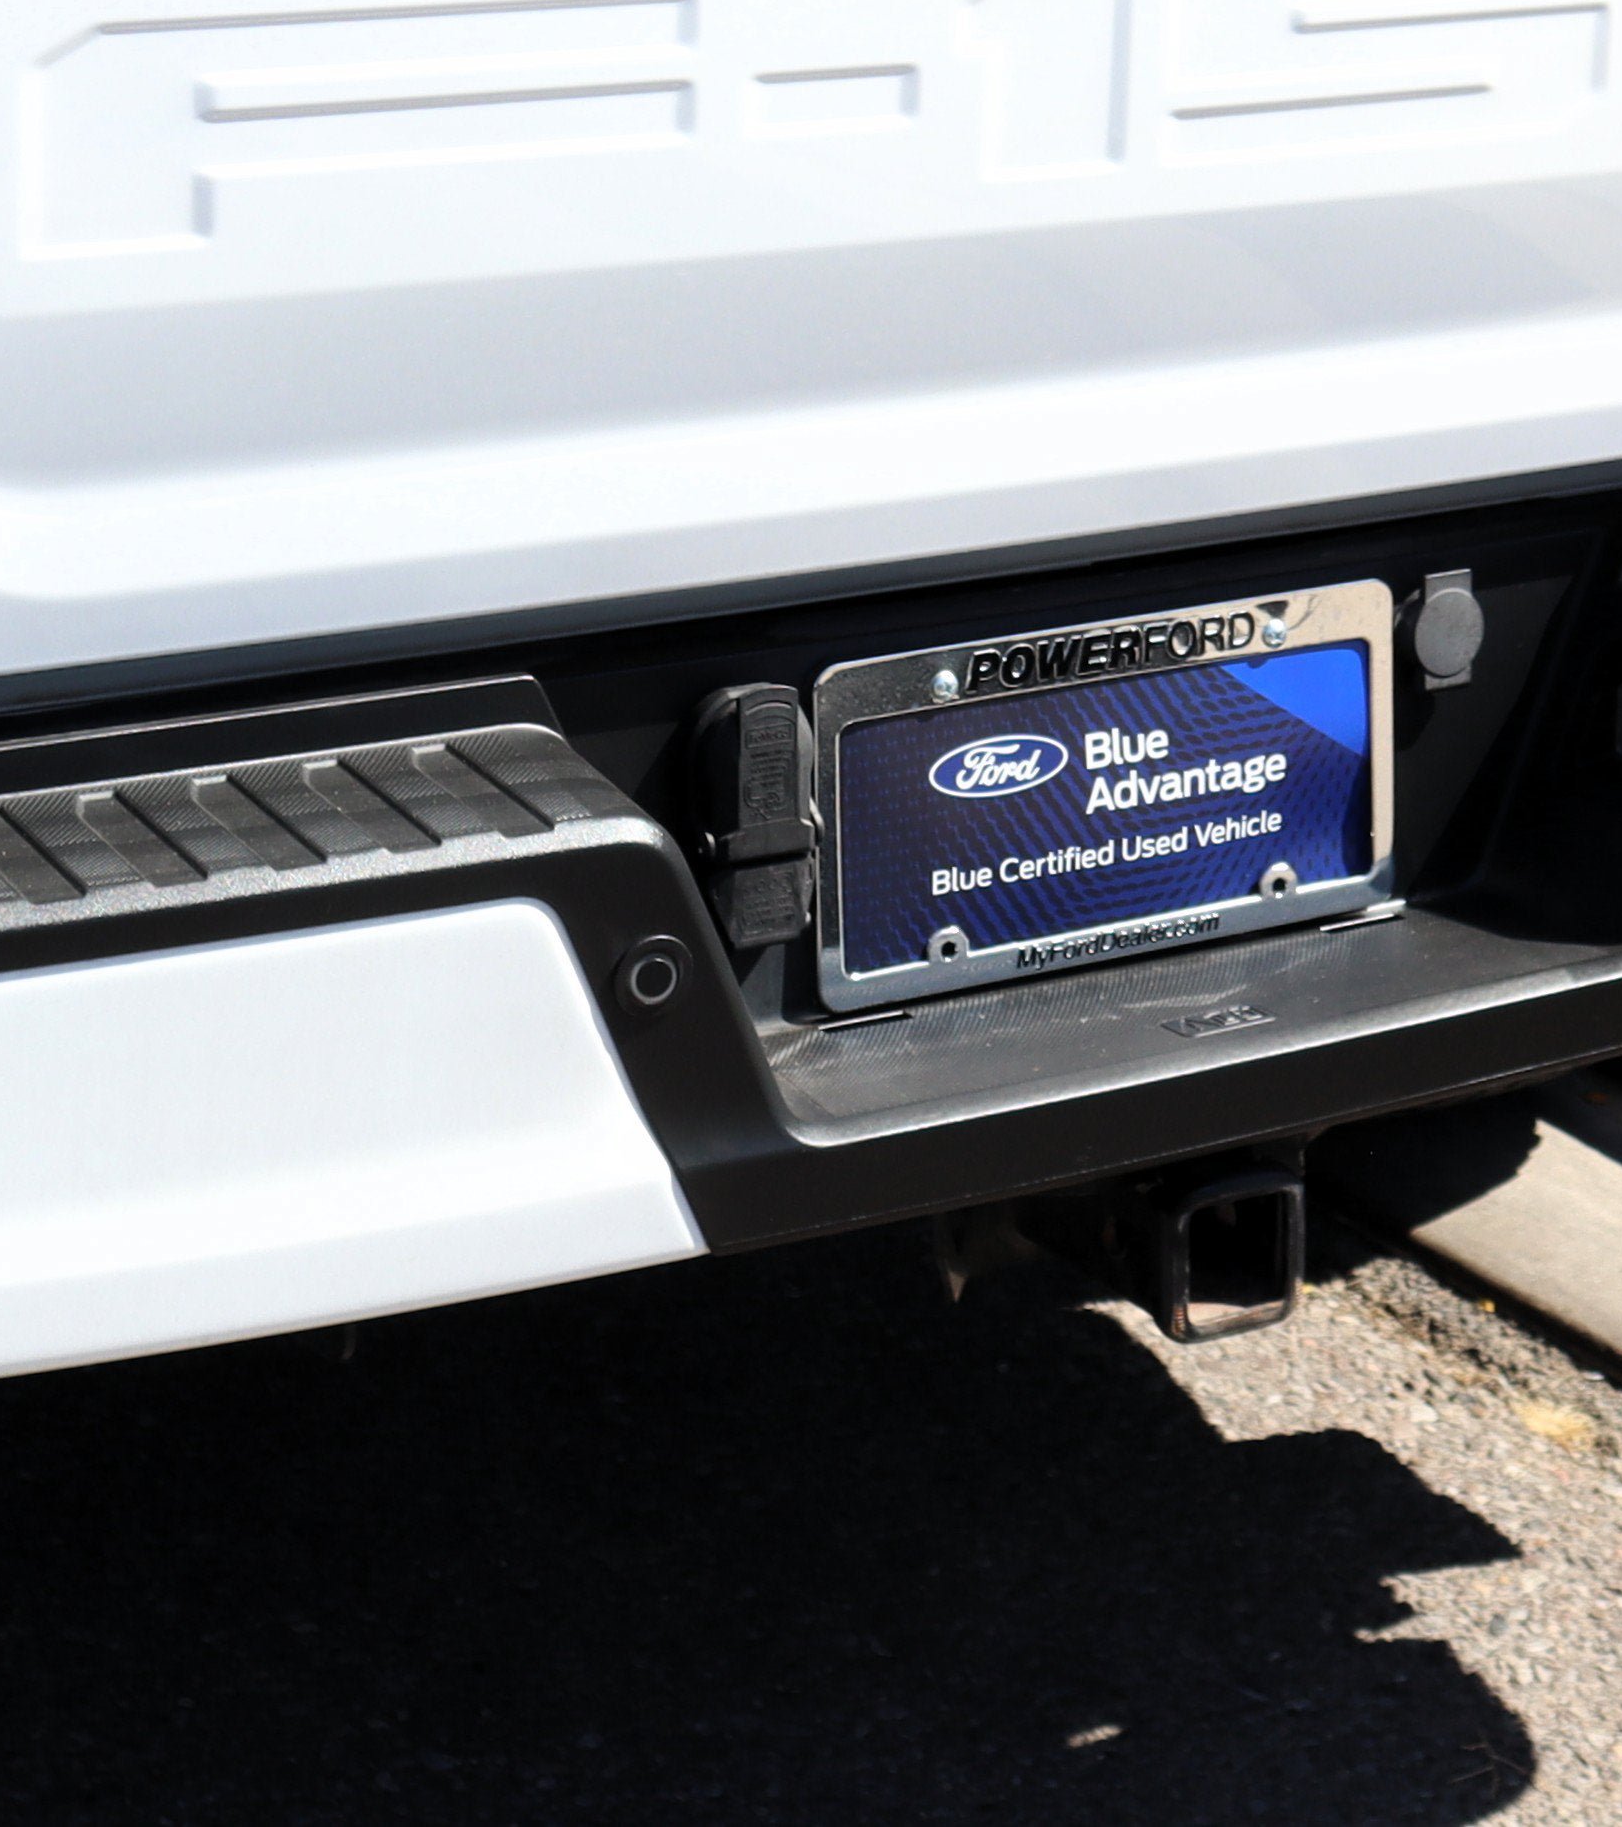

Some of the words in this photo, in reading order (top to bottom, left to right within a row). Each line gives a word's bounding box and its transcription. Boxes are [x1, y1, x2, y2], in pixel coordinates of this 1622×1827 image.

[955, 743, 1042, 791] Ford
[1084, 727, 1169, 770] Blue
[1085, 752, 1288, 816] Advantage
[931, 866, 994, 896] Blue
[999, 838, 1116, 883] Certified
[1121, 825, 1189, 862] Used
[1193, 809, 1283, 848] Vehicle
